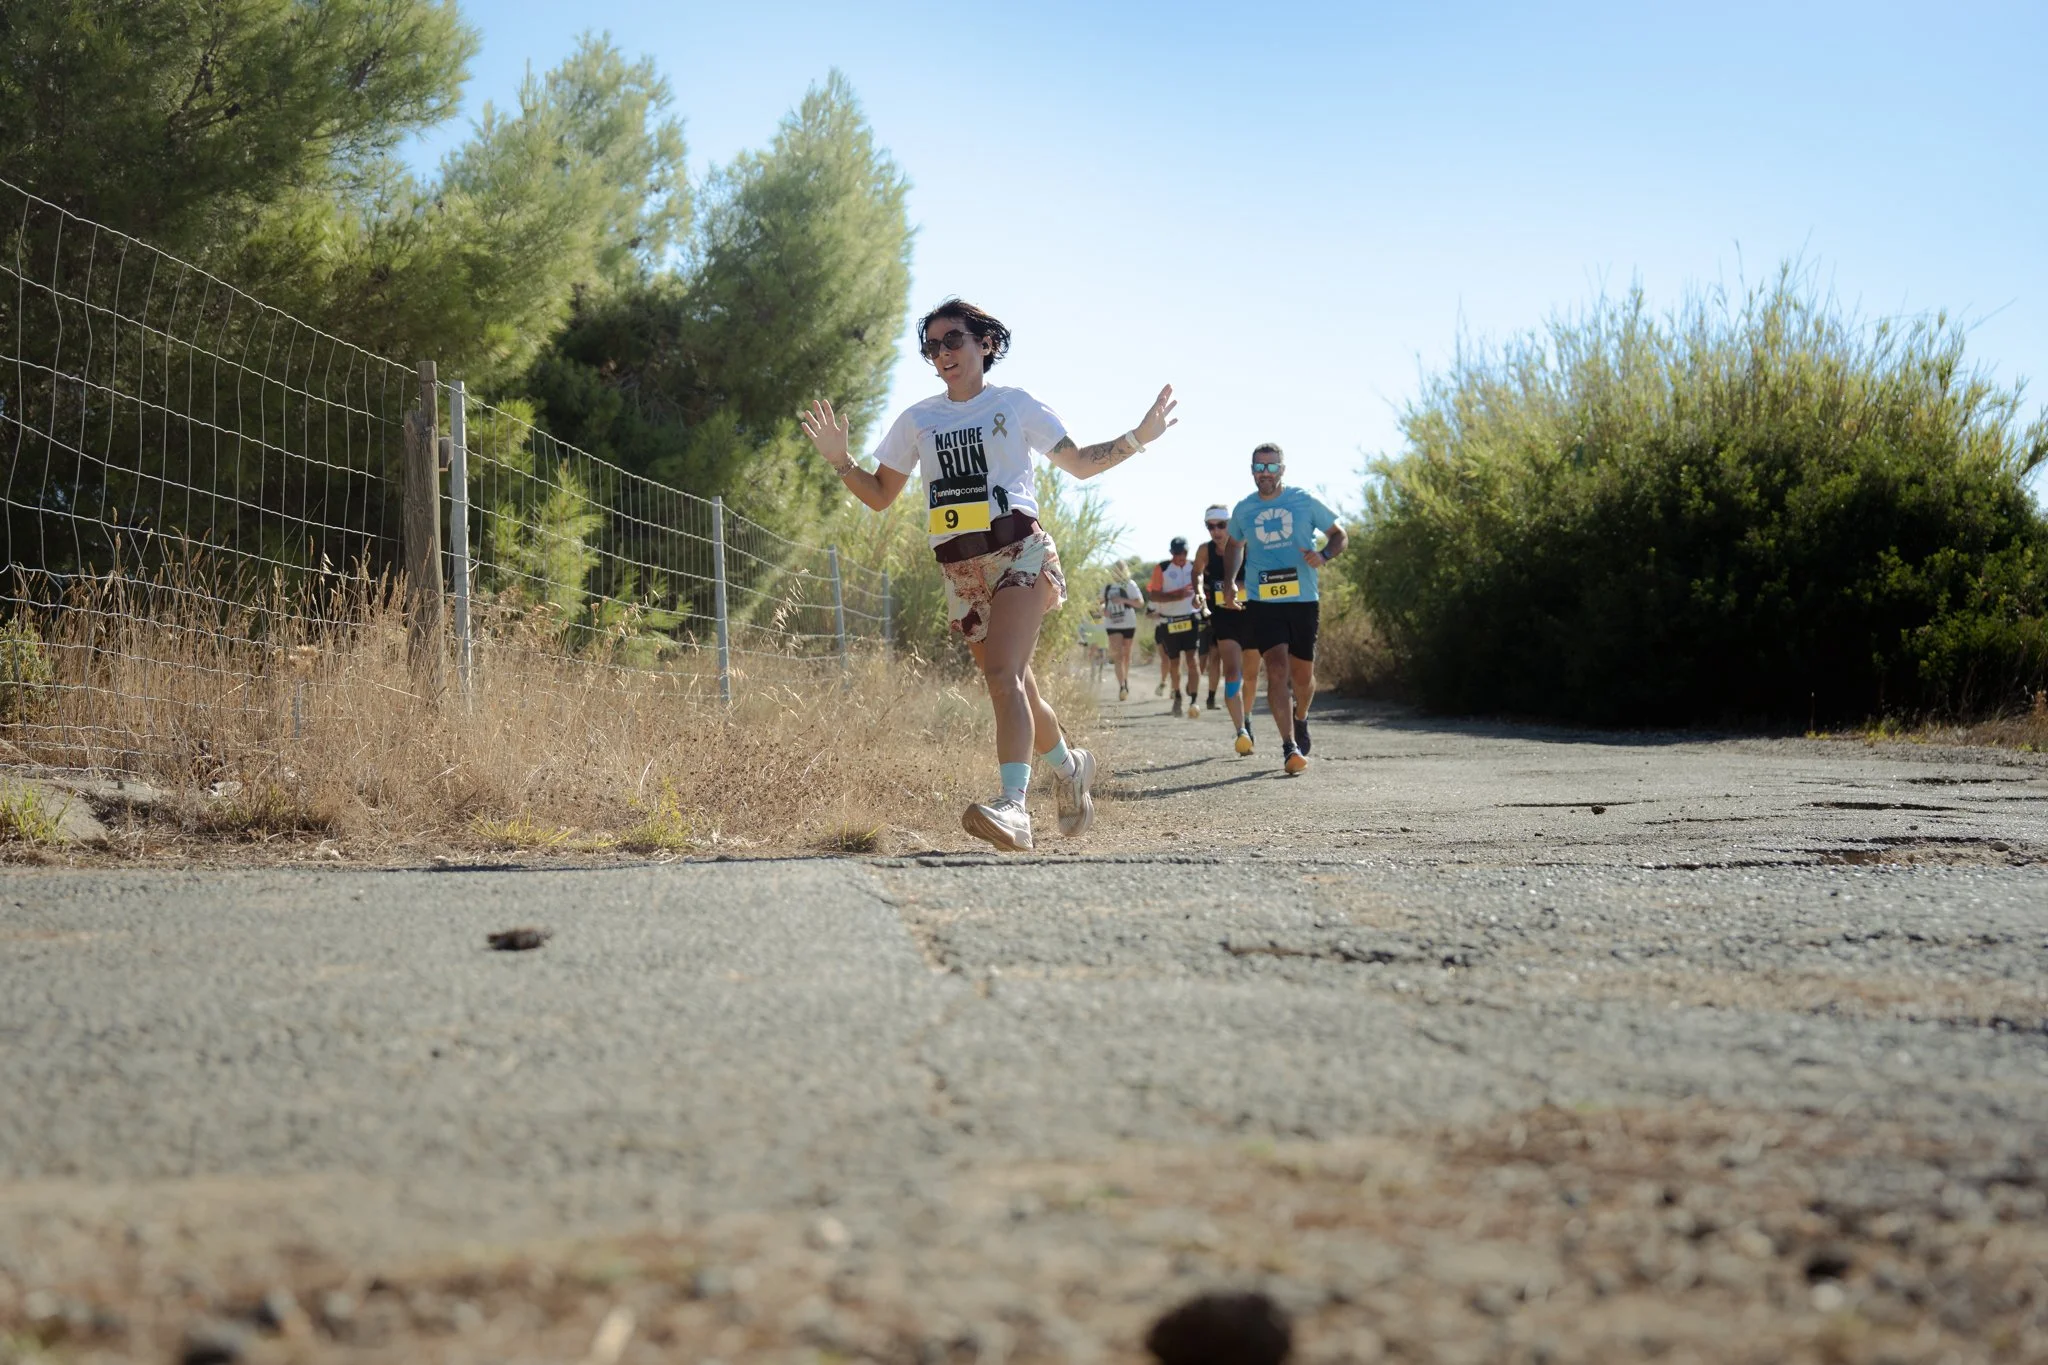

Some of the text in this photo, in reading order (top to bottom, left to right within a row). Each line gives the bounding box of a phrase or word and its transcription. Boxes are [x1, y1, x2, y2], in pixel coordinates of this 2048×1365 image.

[935, 426, 983, 450] NATURE
[937, 443, 988, 478] RUN
[944, 509, 959, 529] 9
[1270, 585, 1288, 597] 68
